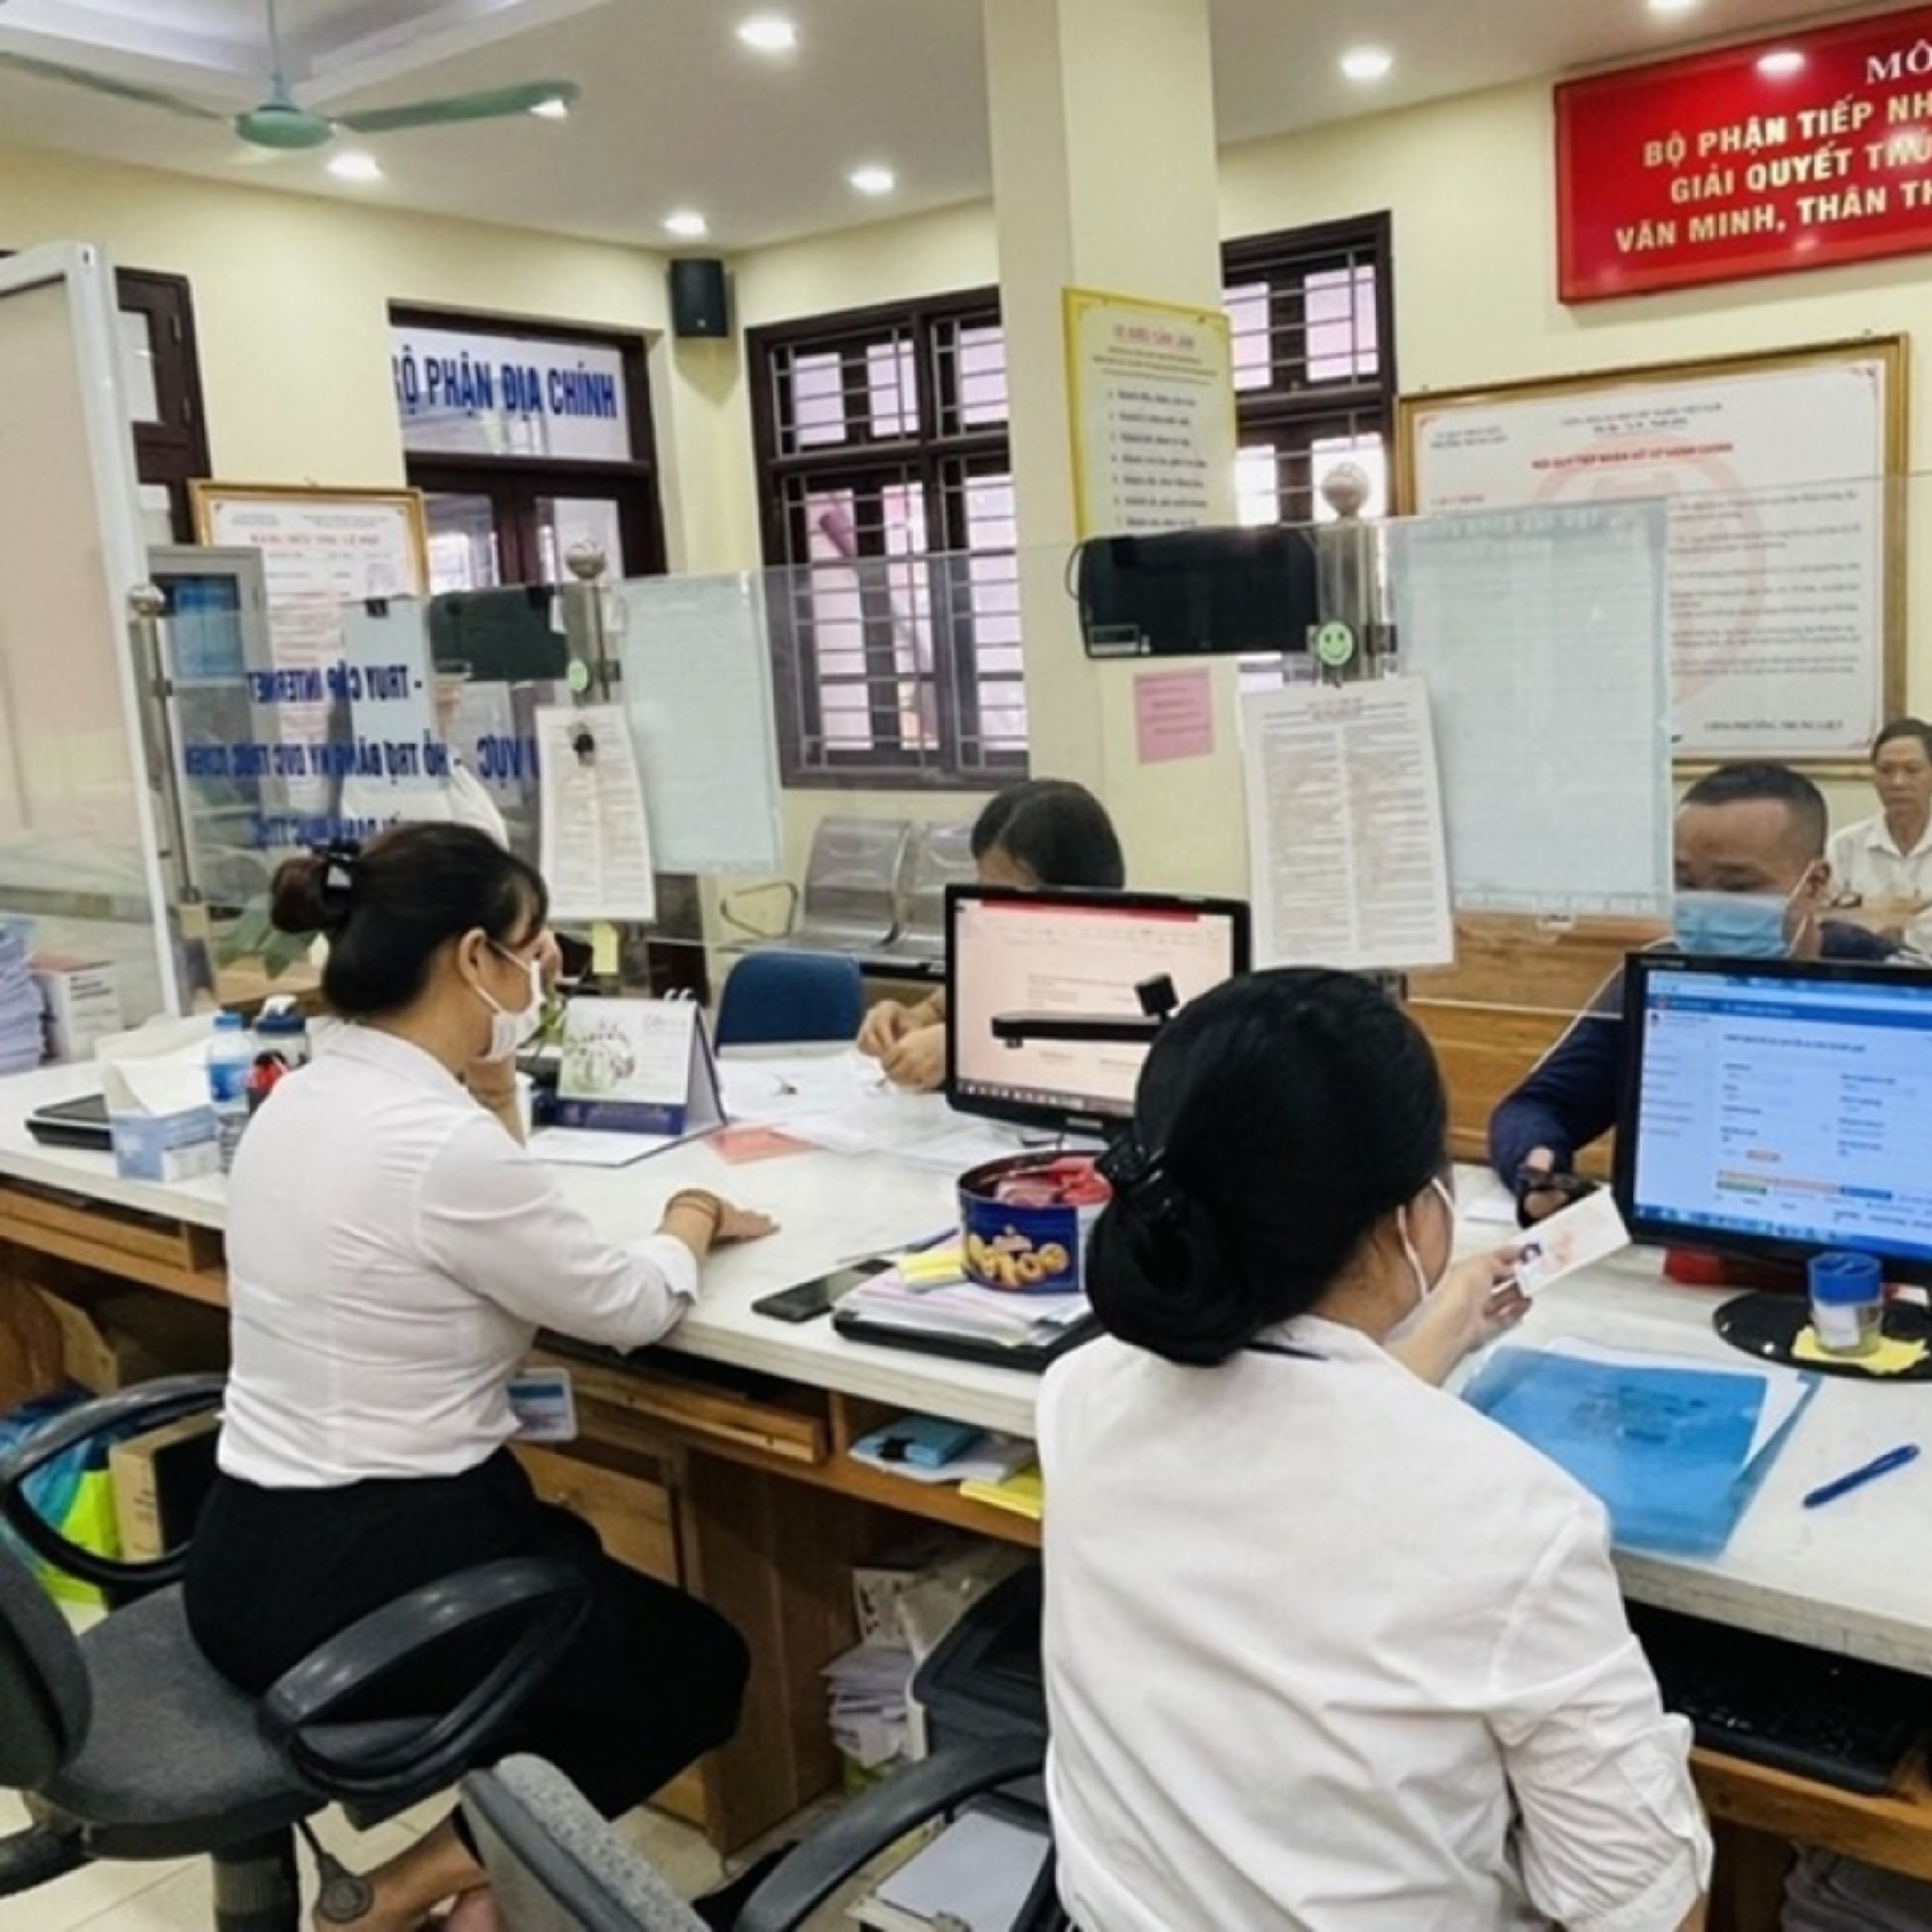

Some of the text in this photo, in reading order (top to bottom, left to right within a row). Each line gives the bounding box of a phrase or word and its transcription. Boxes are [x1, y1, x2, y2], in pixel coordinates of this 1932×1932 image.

[1643, 131, 1687, 168] BỘ
[1697, 115, 1788, 155] PHẬN
[1797, 93, 1873, 140] TIẾP
[1671, 162, 1734, 204] GIẢI
[1746, 141, 1853, 191] QUYẾT
[1616, 219, 1678, 252] VĂN
[1688, 203, 1786, 243] MINH,
[1796, 185, 1887, 225] THÂN
[424, 350, 494, 417] PHẬN
[500, 362, 543, 422] ĐỊA
[547, 360, 618, 420] CHÍNH
